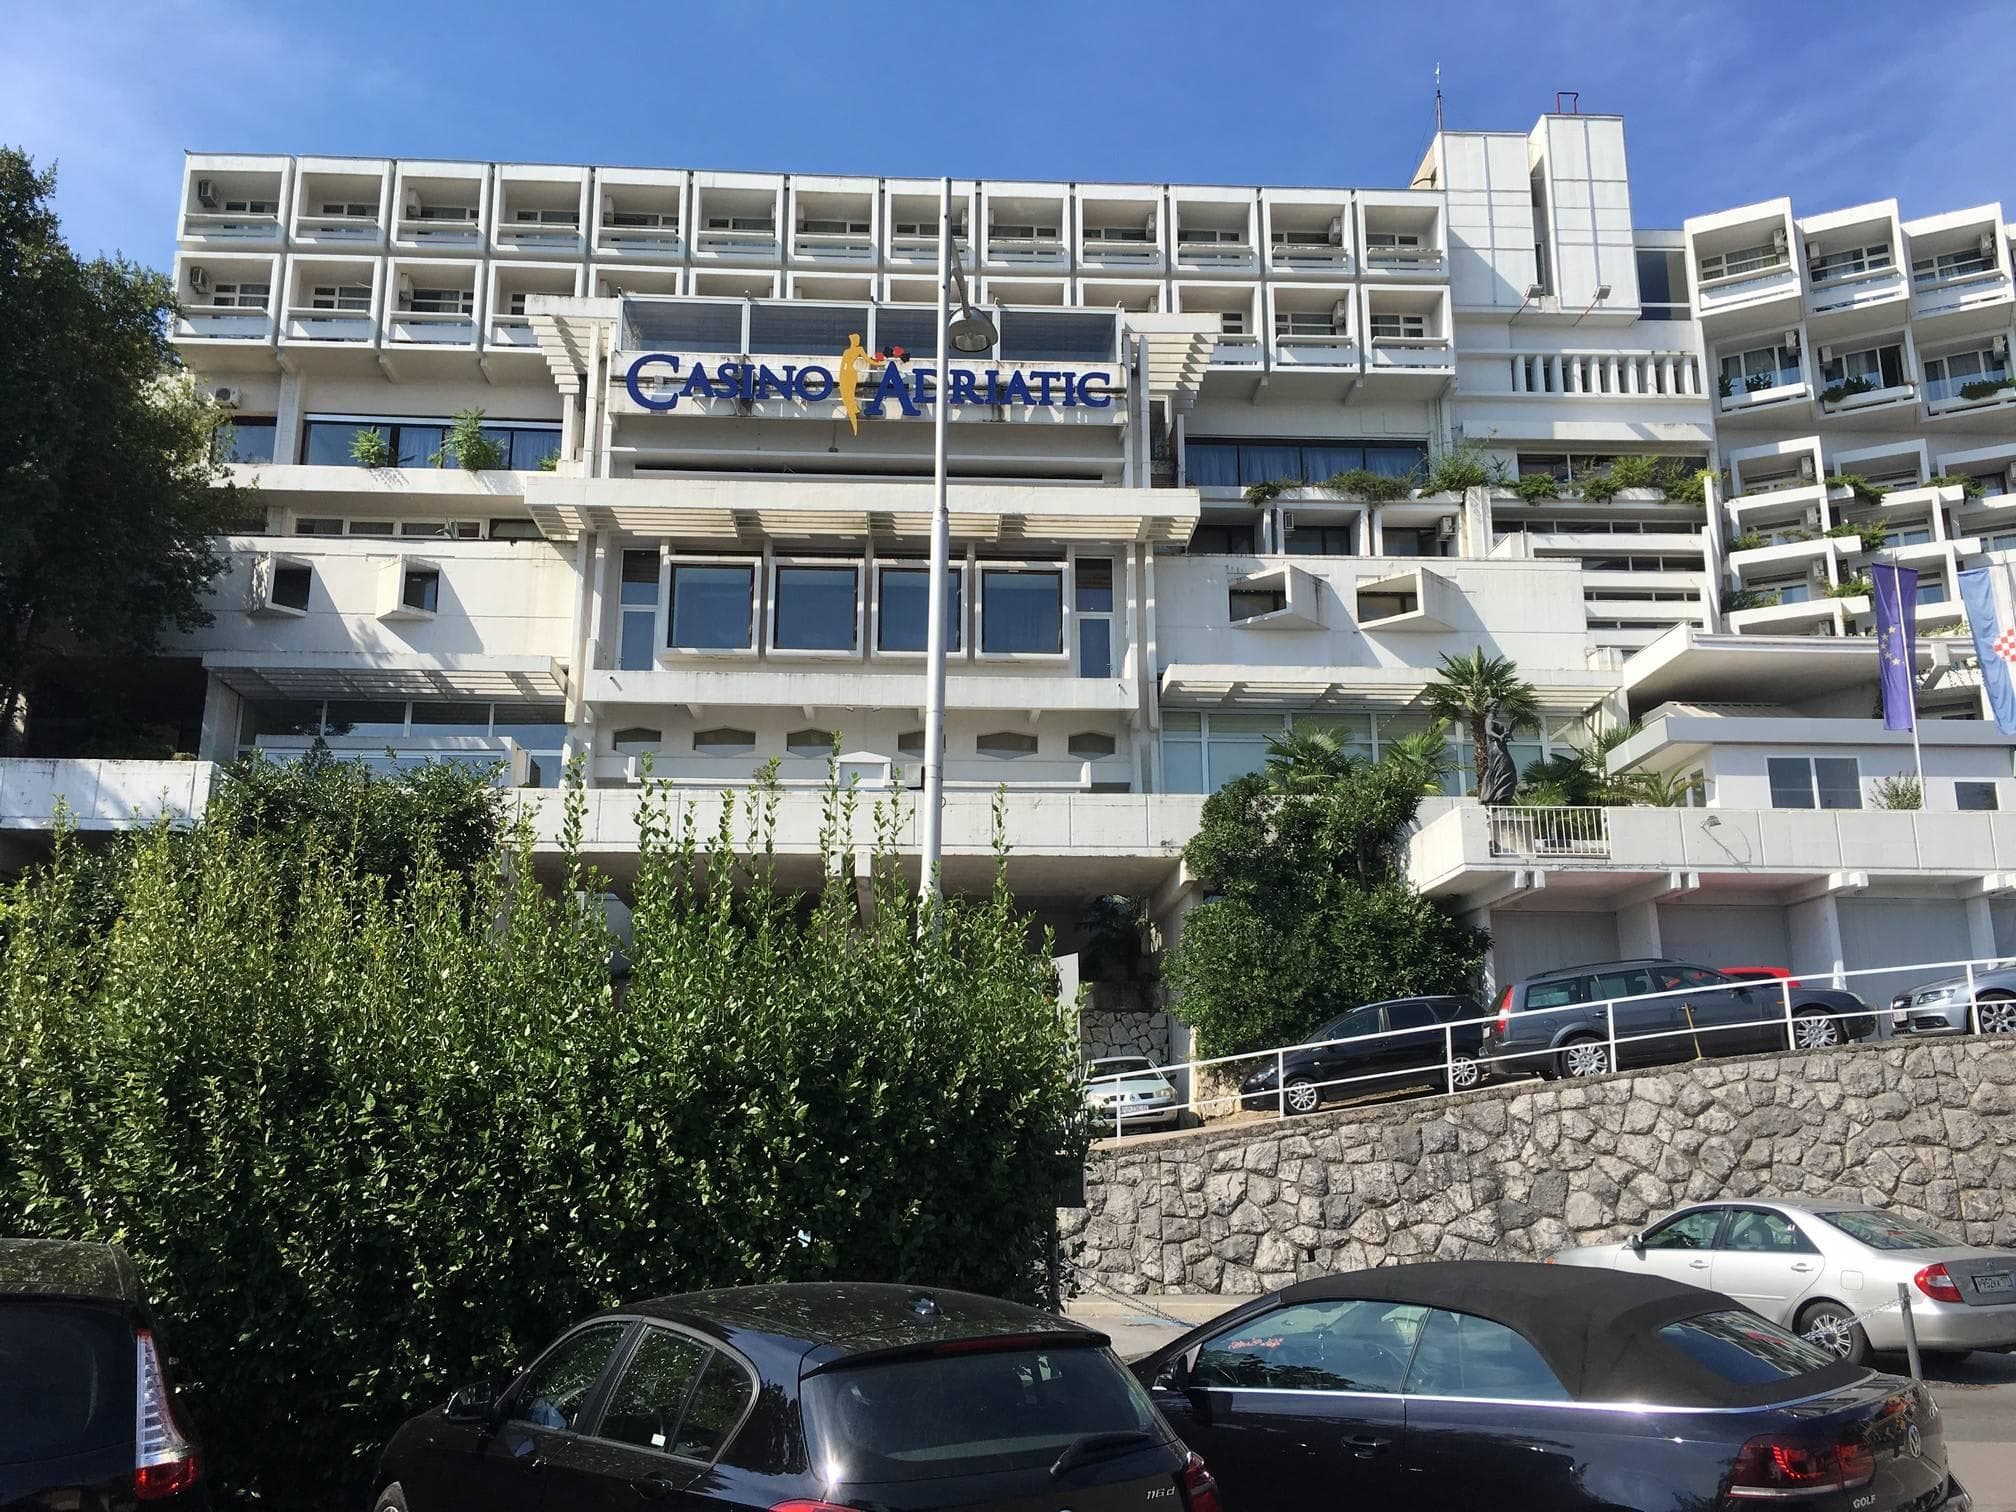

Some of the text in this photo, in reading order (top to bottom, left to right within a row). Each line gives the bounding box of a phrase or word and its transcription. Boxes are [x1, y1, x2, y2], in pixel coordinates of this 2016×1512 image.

[626, 354, 1112, 417] CASINO ADRIATIC
[1853, 1494, 1876, 1508] GOLF
